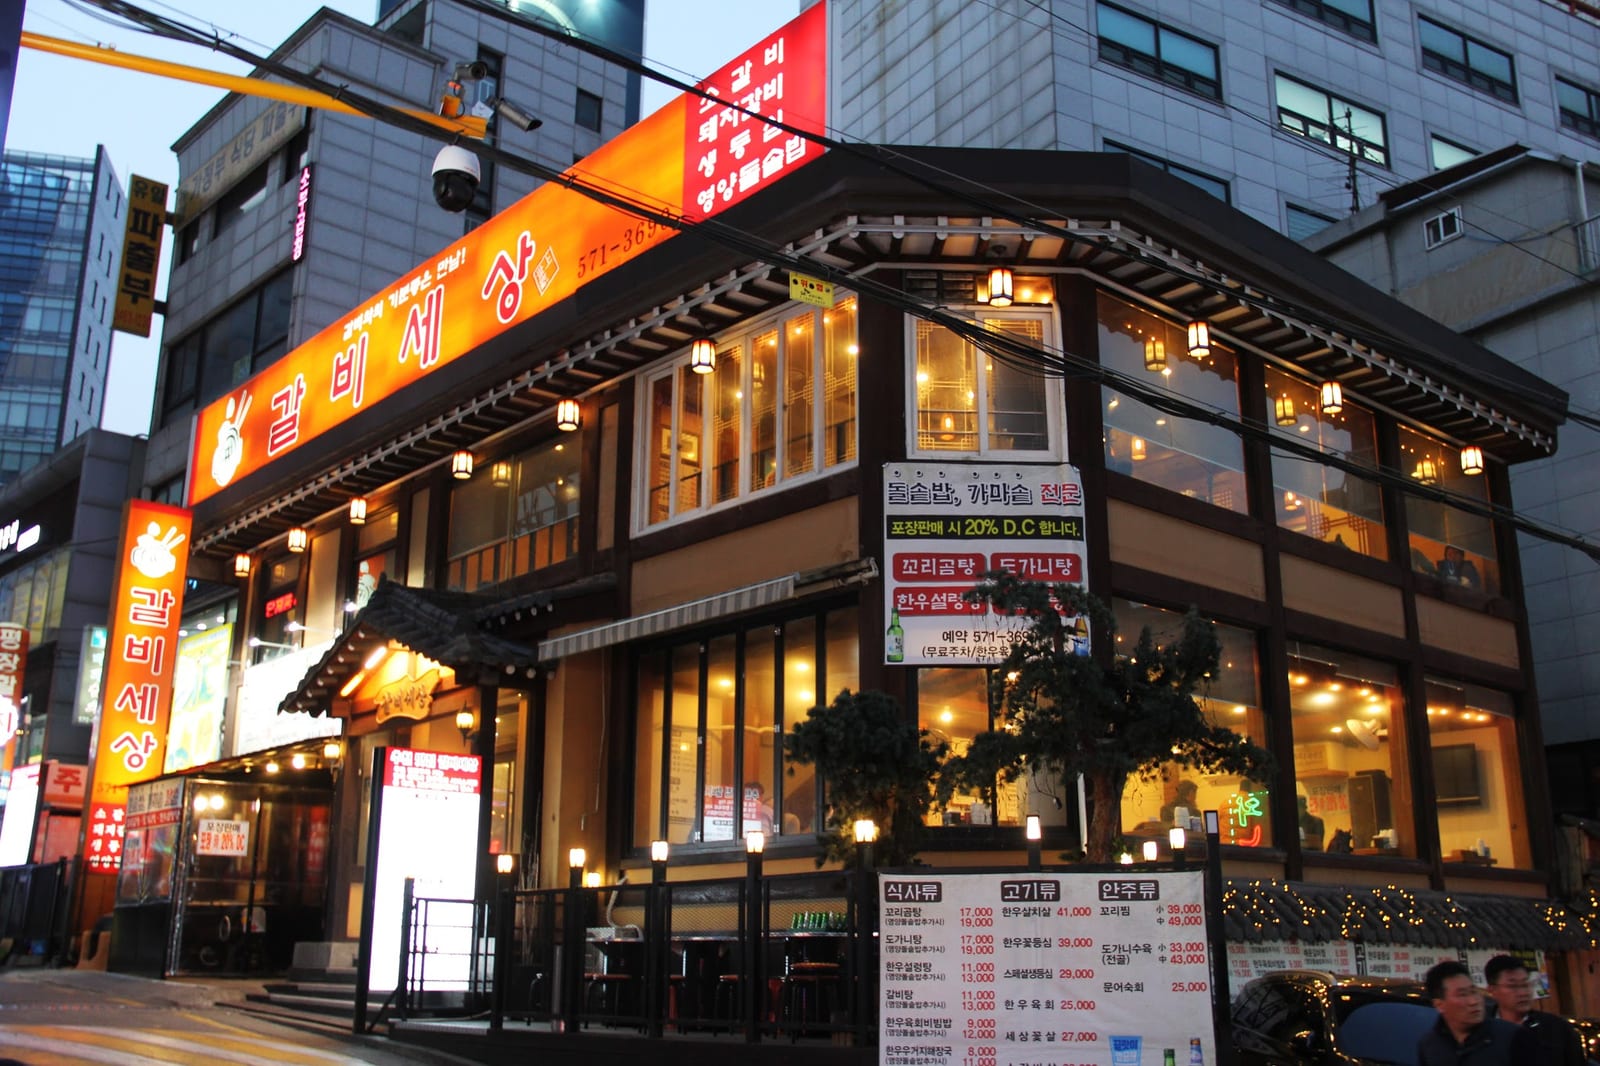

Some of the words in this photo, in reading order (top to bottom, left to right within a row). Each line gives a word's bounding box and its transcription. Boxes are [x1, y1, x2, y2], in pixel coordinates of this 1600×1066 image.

[698, 72, 784, 143] 돼지갈비
[697, 134, 806, 213] 영양돌솥밥
[121, 207, 161, 305] 파출부
[267, 230, 536, 456] 갈비세상
[888, 481, 962, 507] 돌솥밥,
[967, 483, 1033, 506] 가마솥
[1040, 483, 1082, 506] 전문
[891, 520, 944, 536] 포장판매
[948, 520, 961, 536] 시
[964, 519, 999, 536] 20%
[1003, 519, 1036, 536] D.C
[1039, 521, 1081, 537] 합니다.
[902, 558, 976, 576] 꼬리곰탕
[942, 631, 969, 643] 예약
[109, 585, 175, 773] 갈비세상
[887, 883, 938, 900] 식사류
[1003, 882, 1056, 900] 고기류
[1102, 882, 1156, 899] 안주류
[885, 907, 922, 917] 꼬리곰탕
[1002, 907, 1051, 917] 한우살치살
[1057, 907, 1092, 917] 41,000
[1100, 905, 1131, 917] 꼬리찜
[1167, 904, 1202, 914] 39,000
[1168, 916, 1202, 926] 49,000
[885, 934, 922, 945] 도가니탕
[1003, 937, 1052, 948] 한우꽃등심
[1058, 938, 1093, 948] 39,000
[1101, 943, 1152, 954] 도가니수육
[1170, 942, 1204, 953] 33,000
[1102, 954, 1131, 965] (전골)
[1170, 954, 1205, 965] 43,000
[886, 961, 932, 972] 한우설렁탕
[1003, 968, 1053, 979] 스페셜생등심
[1059, 969, 1094, 979] 29,000
[1103, 982, 1144, 993] 문어숙회
[886, 989, 914, 1000] 갈비탕
[1061, 1000, 1096, 1011] 25,000
[886, 1017, 952, 1028] 한우육회비빔밥
[1062, 1032, 1097, 1043] 27,000
[886, 1045, 952, 1057] 한우우거지해장국
